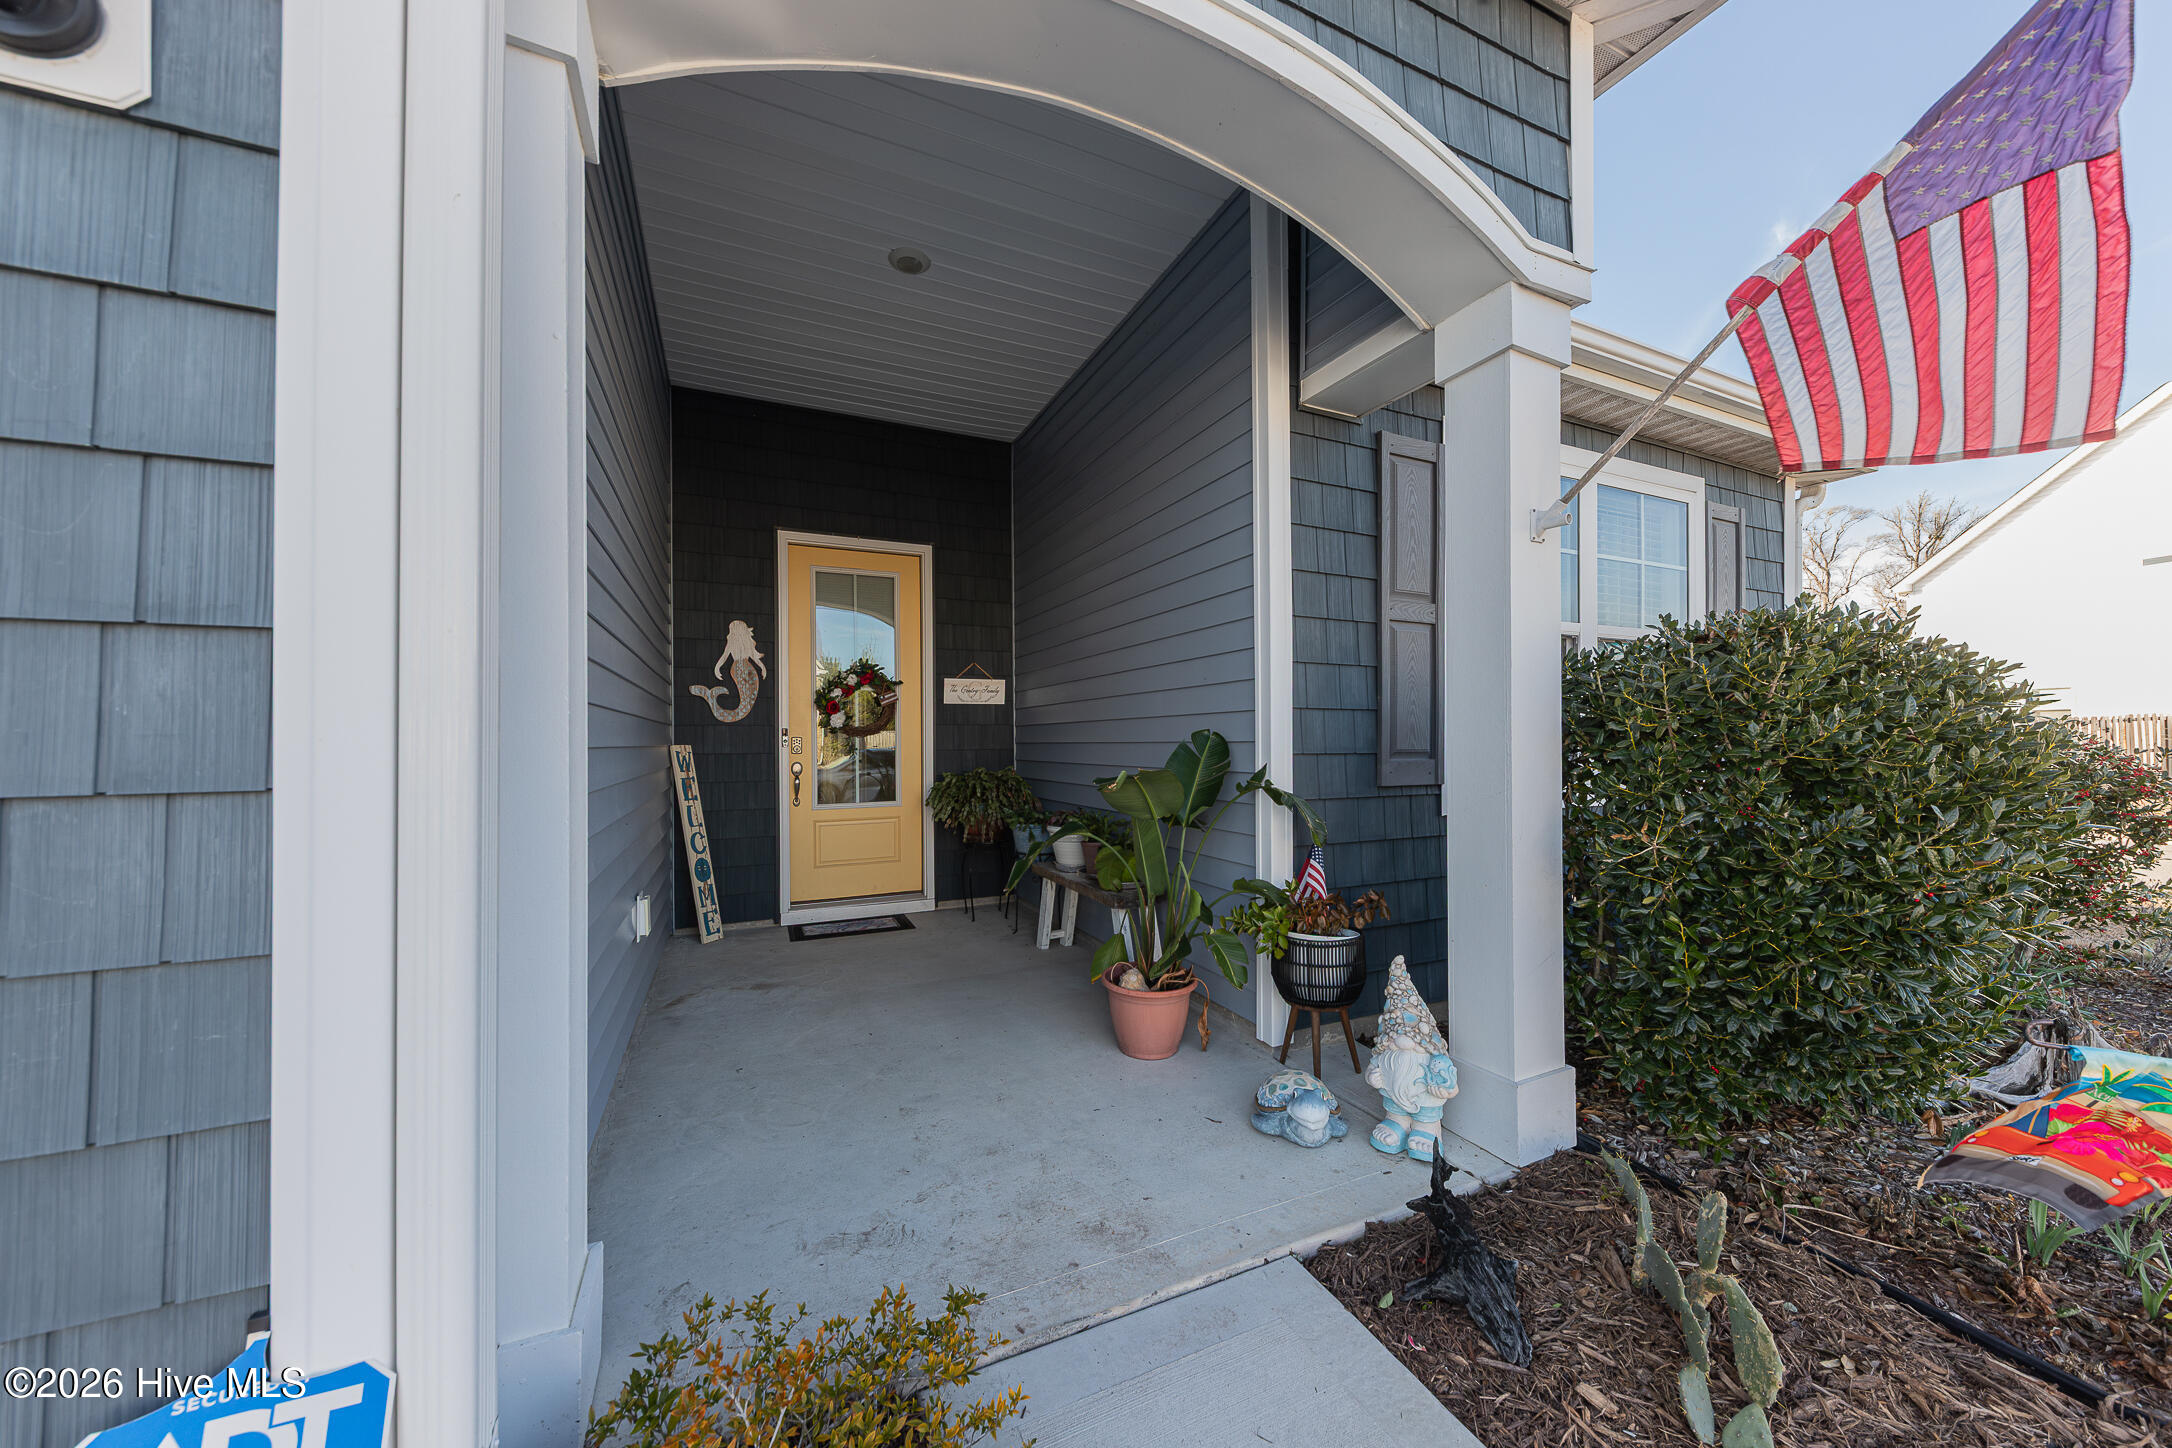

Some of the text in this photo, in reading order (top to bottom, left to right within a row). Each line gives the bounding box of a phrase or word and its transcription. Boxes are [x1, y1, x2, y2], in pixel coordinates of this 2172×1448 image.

[950, 684, 959, 693] The
[982, 684, 1000, 696] Family
[674, 750, 721, 937] WELCOME
[157, 1382, 365, 1448] DT
